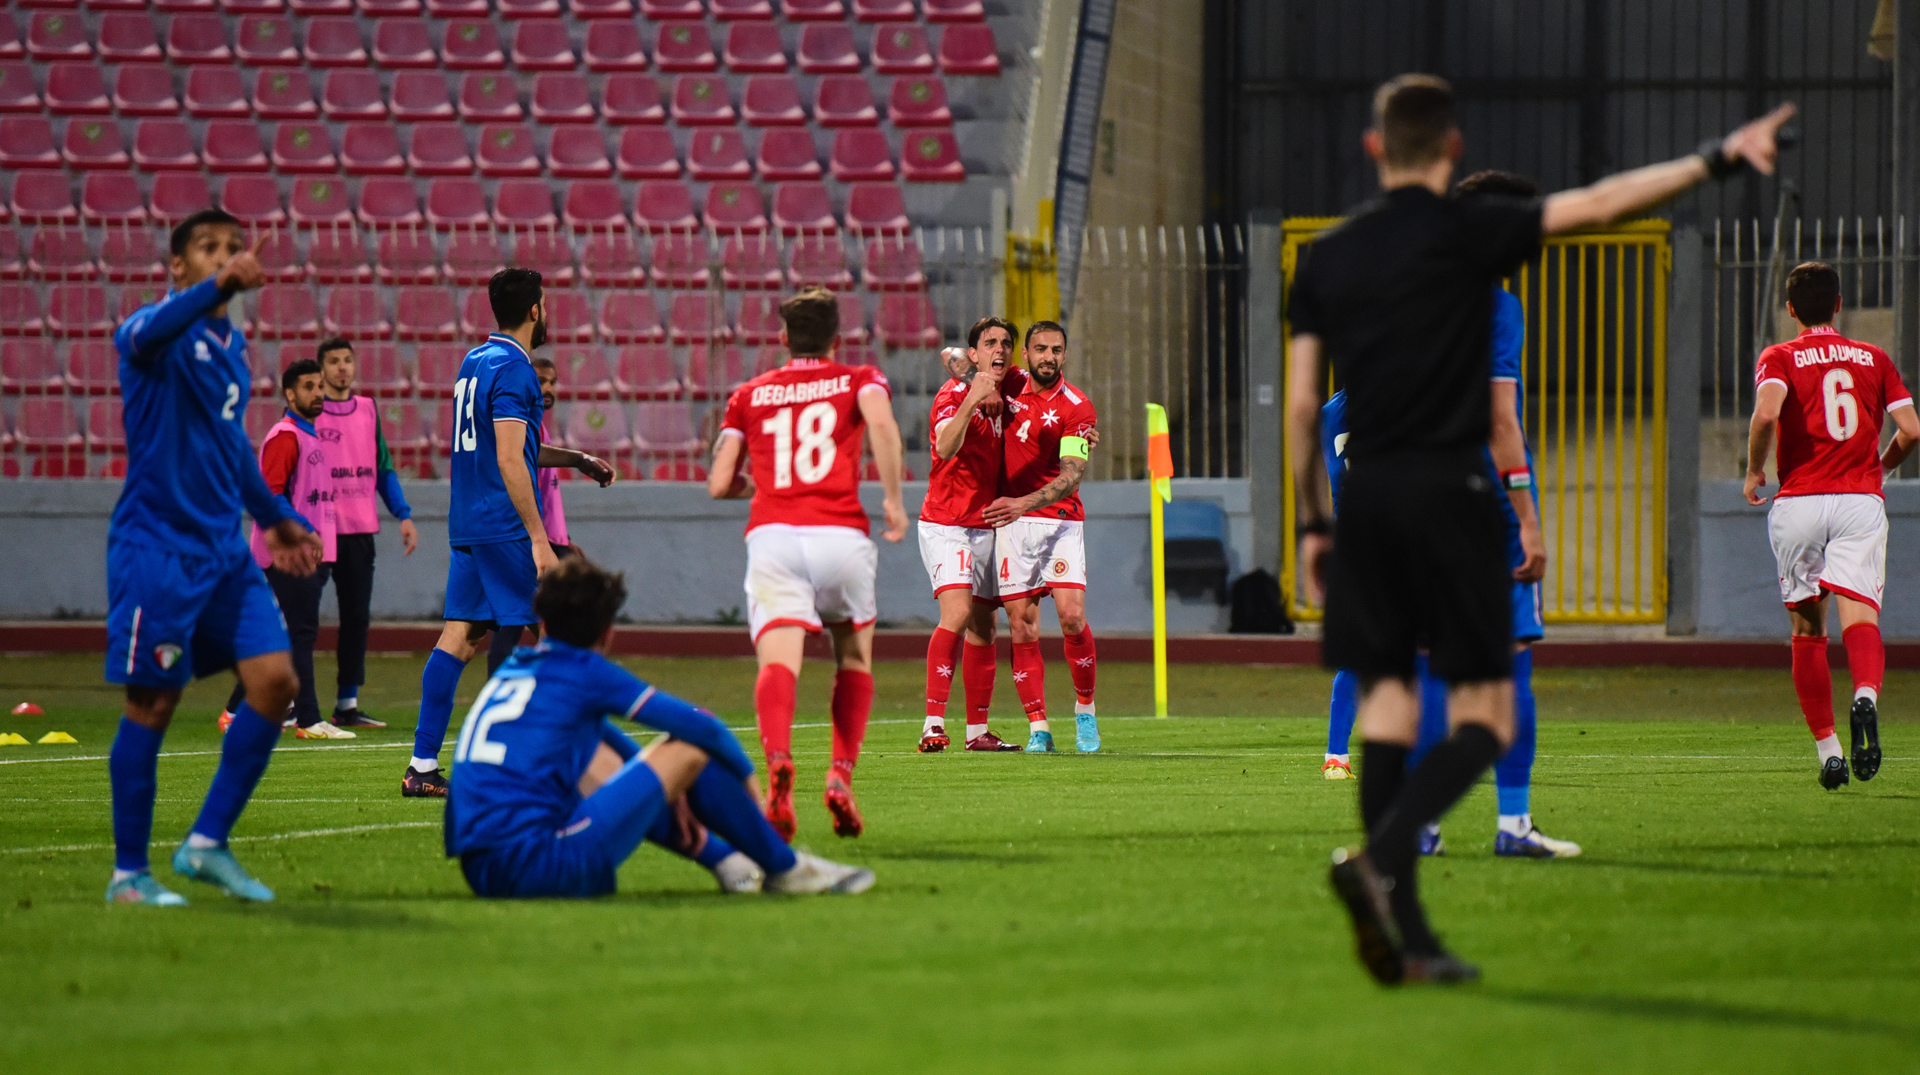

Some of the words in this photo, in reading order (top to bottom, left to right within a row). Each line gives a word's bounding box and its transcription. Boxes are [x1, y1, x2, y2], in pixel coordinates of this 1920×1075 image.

[1793, 344, 1875, 368] GUILLAUMIER
[221, 382, 240, 420] 2
[750, 374, 852, 407] DEGABRIELE
[1822, 367, 1859, 442] 6
[453, 376, 478, 453] 13
[987, 415, 1003, 438] 14
[761, 400, 838, 489] 18
[1015, 419, 1032, 444] 4
[957, 549, 972, 573] 14
[1000, 557, 1010, 582] 4
[456, 676, 537, 765] 12
